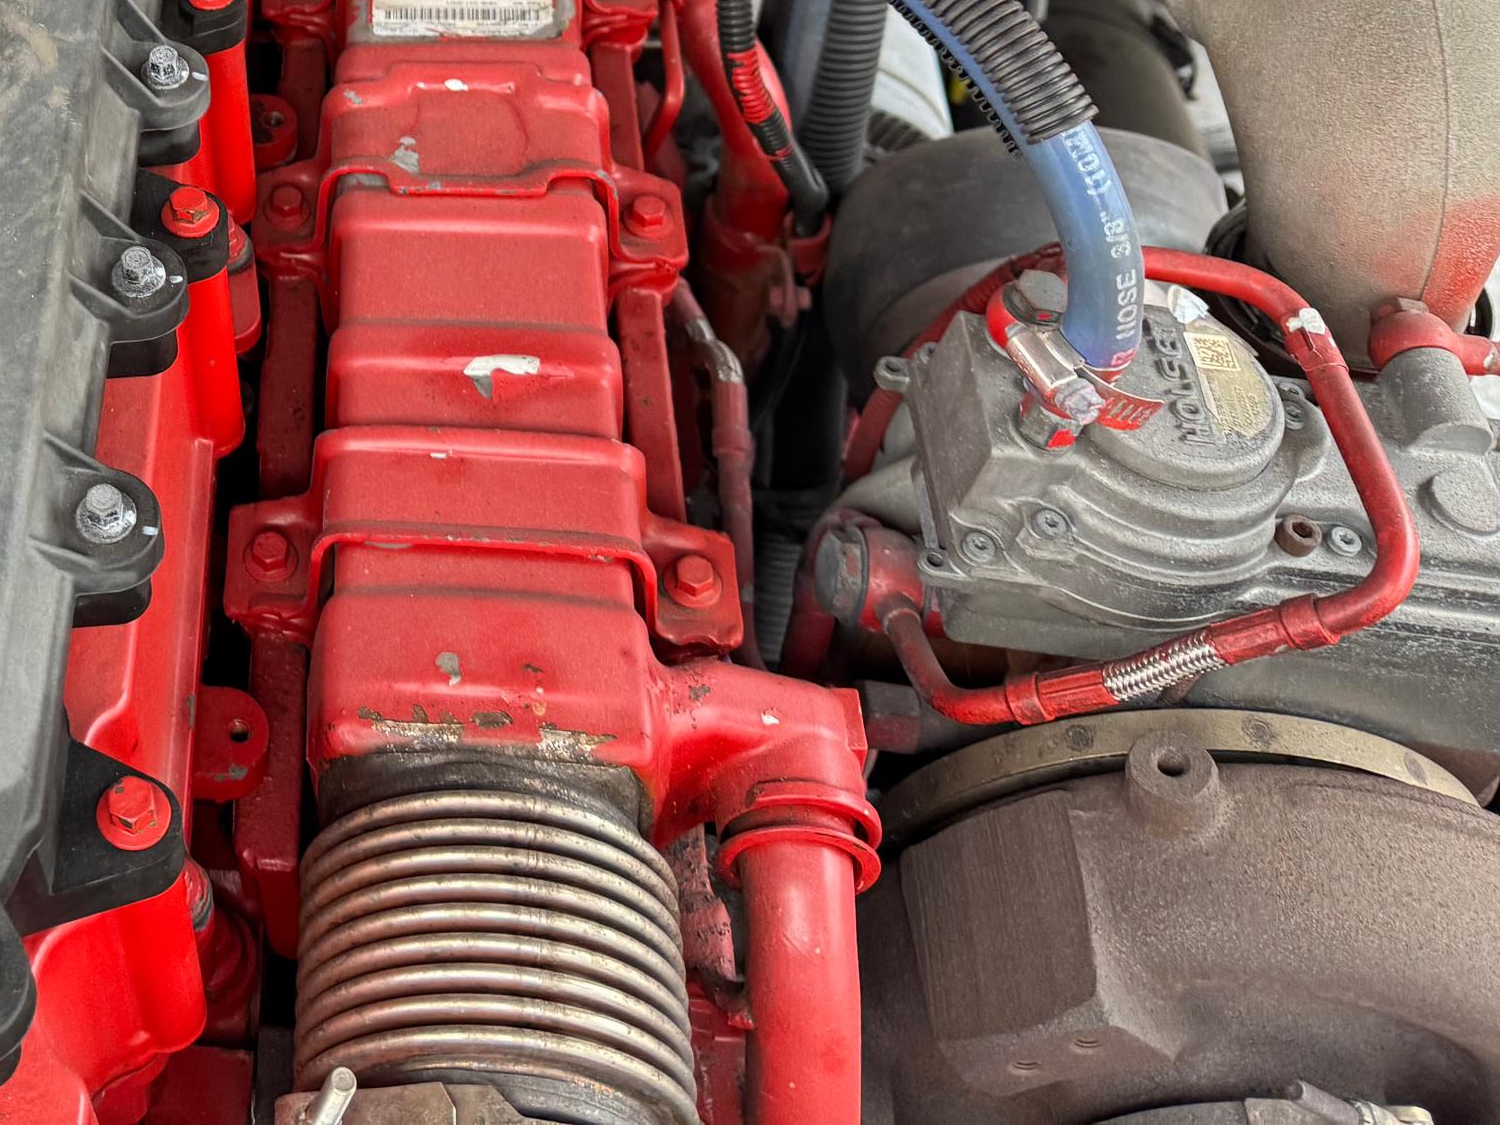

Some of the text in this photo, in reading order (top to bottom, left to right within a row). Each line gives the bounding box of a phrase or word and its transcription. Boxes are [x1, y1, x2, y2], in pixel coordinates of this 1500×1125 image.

[1100, 211, 1132, 259] 3/8"
[1114, 269, 1138, 340] HOSE
[1155, 323, 1212, 445] HOLSET
